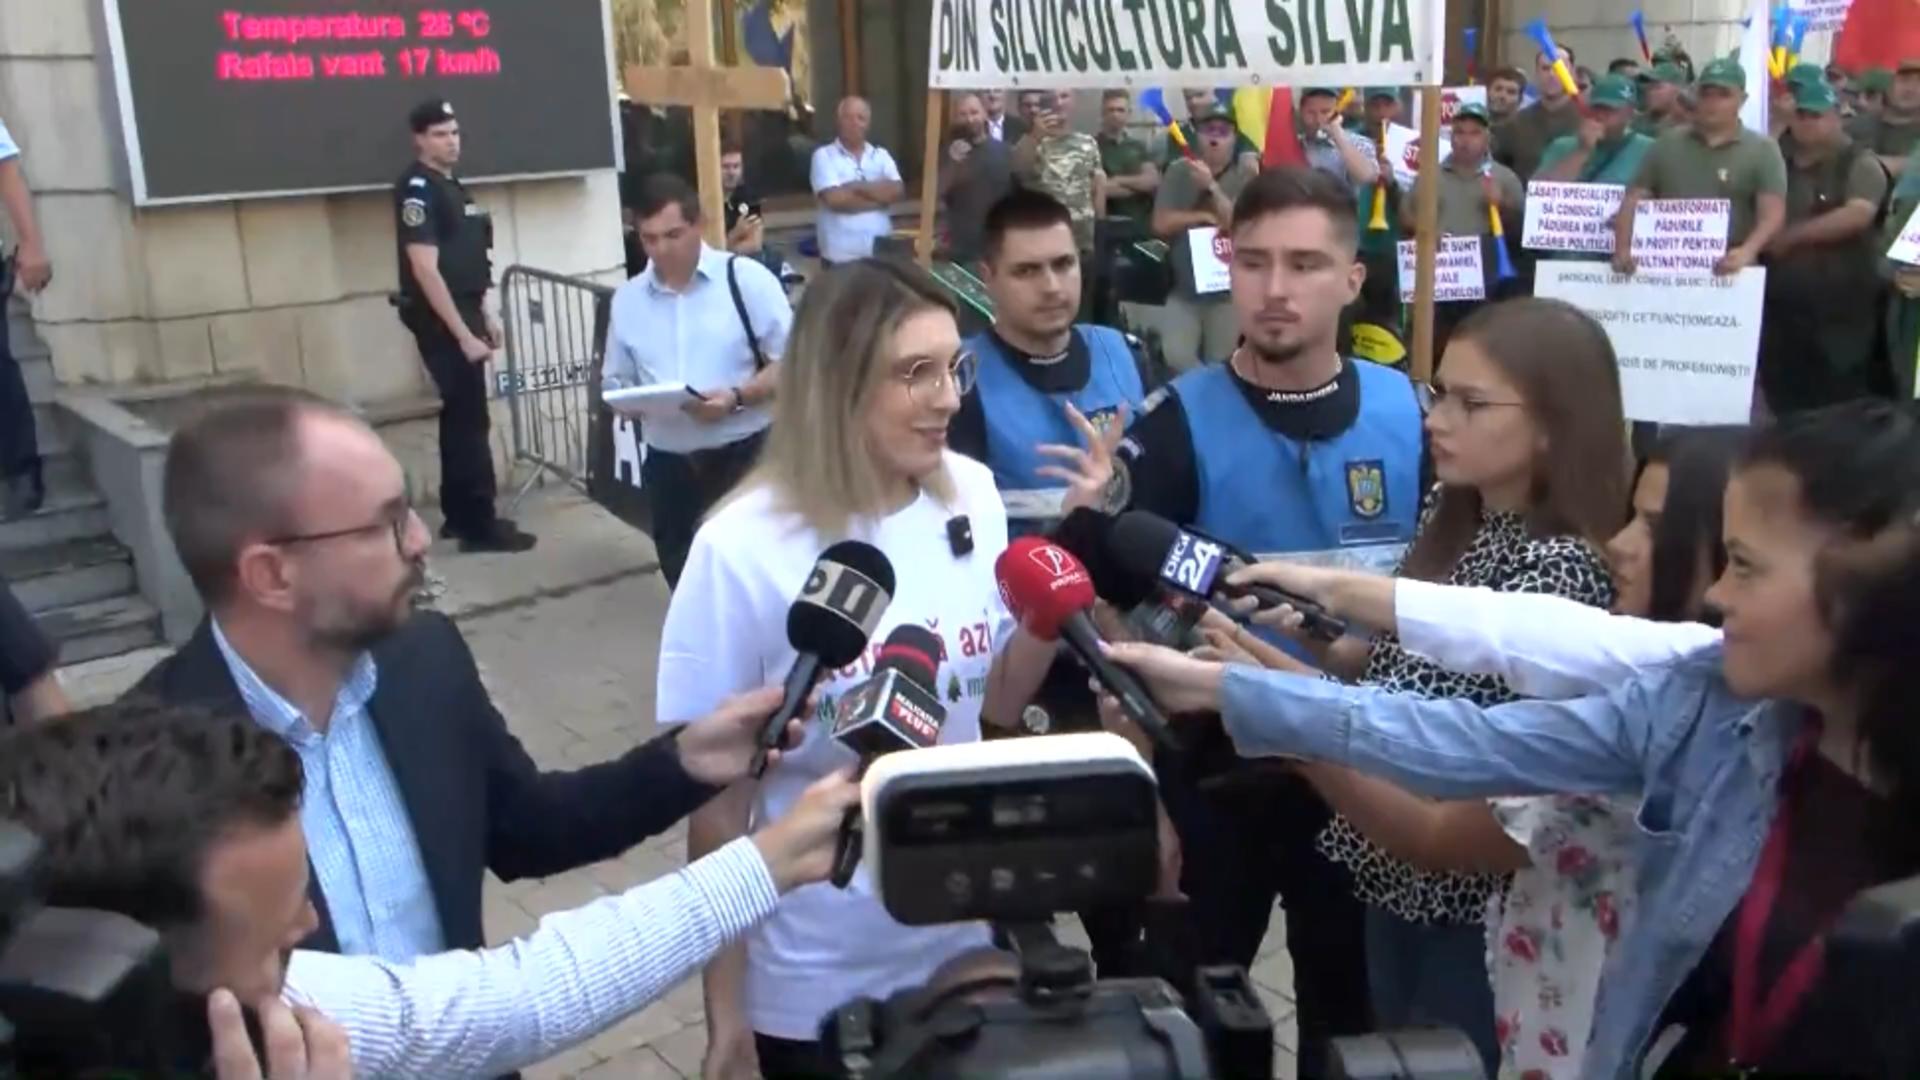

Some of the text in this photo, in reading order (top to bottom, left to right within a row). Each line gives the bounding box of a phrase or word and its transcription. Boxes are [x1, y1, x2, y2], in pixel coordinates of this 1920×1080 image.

[221, 11, 405, 43] Temperatura
[938, 0, 979, 71] DIN
[1267, 0, 1414, 67] SILVA
[320, 51, 386, 76] vant
[398, 48, 430, 76] 17
[436, 48, 500, 75] km/h
[1643, 358, 1658, 370] DE
[1162, 534, 1190, 578] DIGI
[1177, 539, 1222, 592] 24
